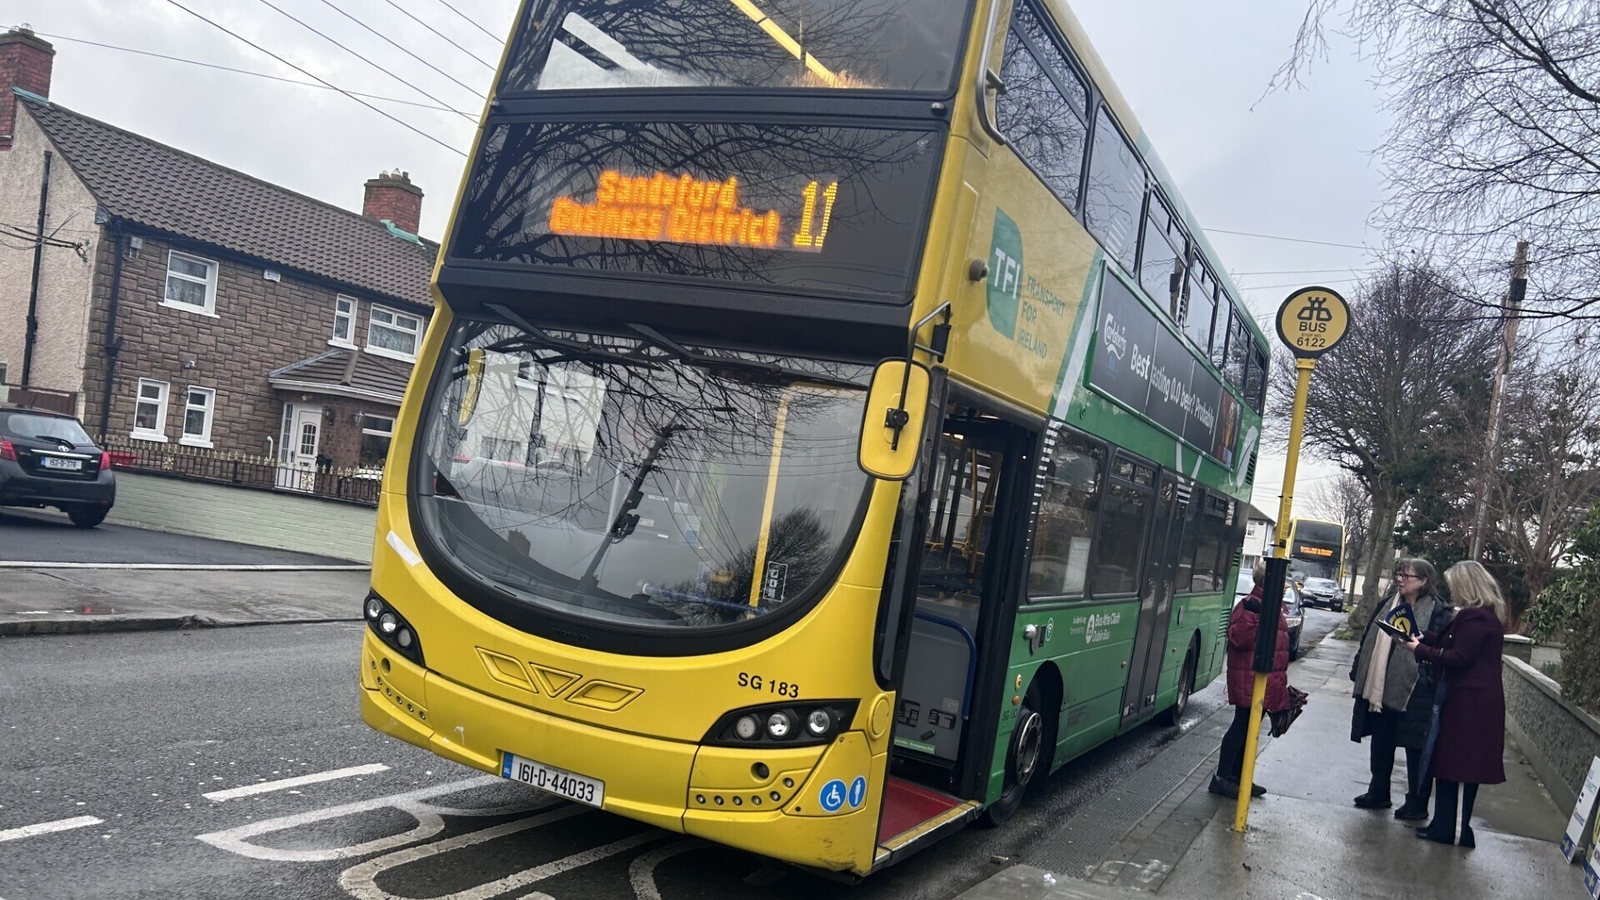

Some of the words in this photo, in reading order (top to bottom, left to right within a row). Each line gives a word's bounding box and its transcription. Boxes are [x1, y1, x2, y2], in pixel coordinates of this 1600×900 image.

[598, 170, 738, 208] Sandyford
[550, 197, 663, 240] Business
[667, 206, 781, 247] District
[794, 179, 838, 248] 11
[995, 247, 1020, 300] TFI
[1021, 300, 1037, 326] FOR
[1026, 274, 1066, 318] TRANSPORT
[1017, 327, 1048, 359] IRELAND
[1297, 336, 1326, 347] 6122
[1299, 321, 1327, 333] BUS
[1130, 343, 1151, 380] Best
[1170, 376, 1182, 404] 0.0
[737, 672, 763, 691] SG
[768, 679, 799, 698] 183
[518, 762, 595, 802] 161-D-44033
